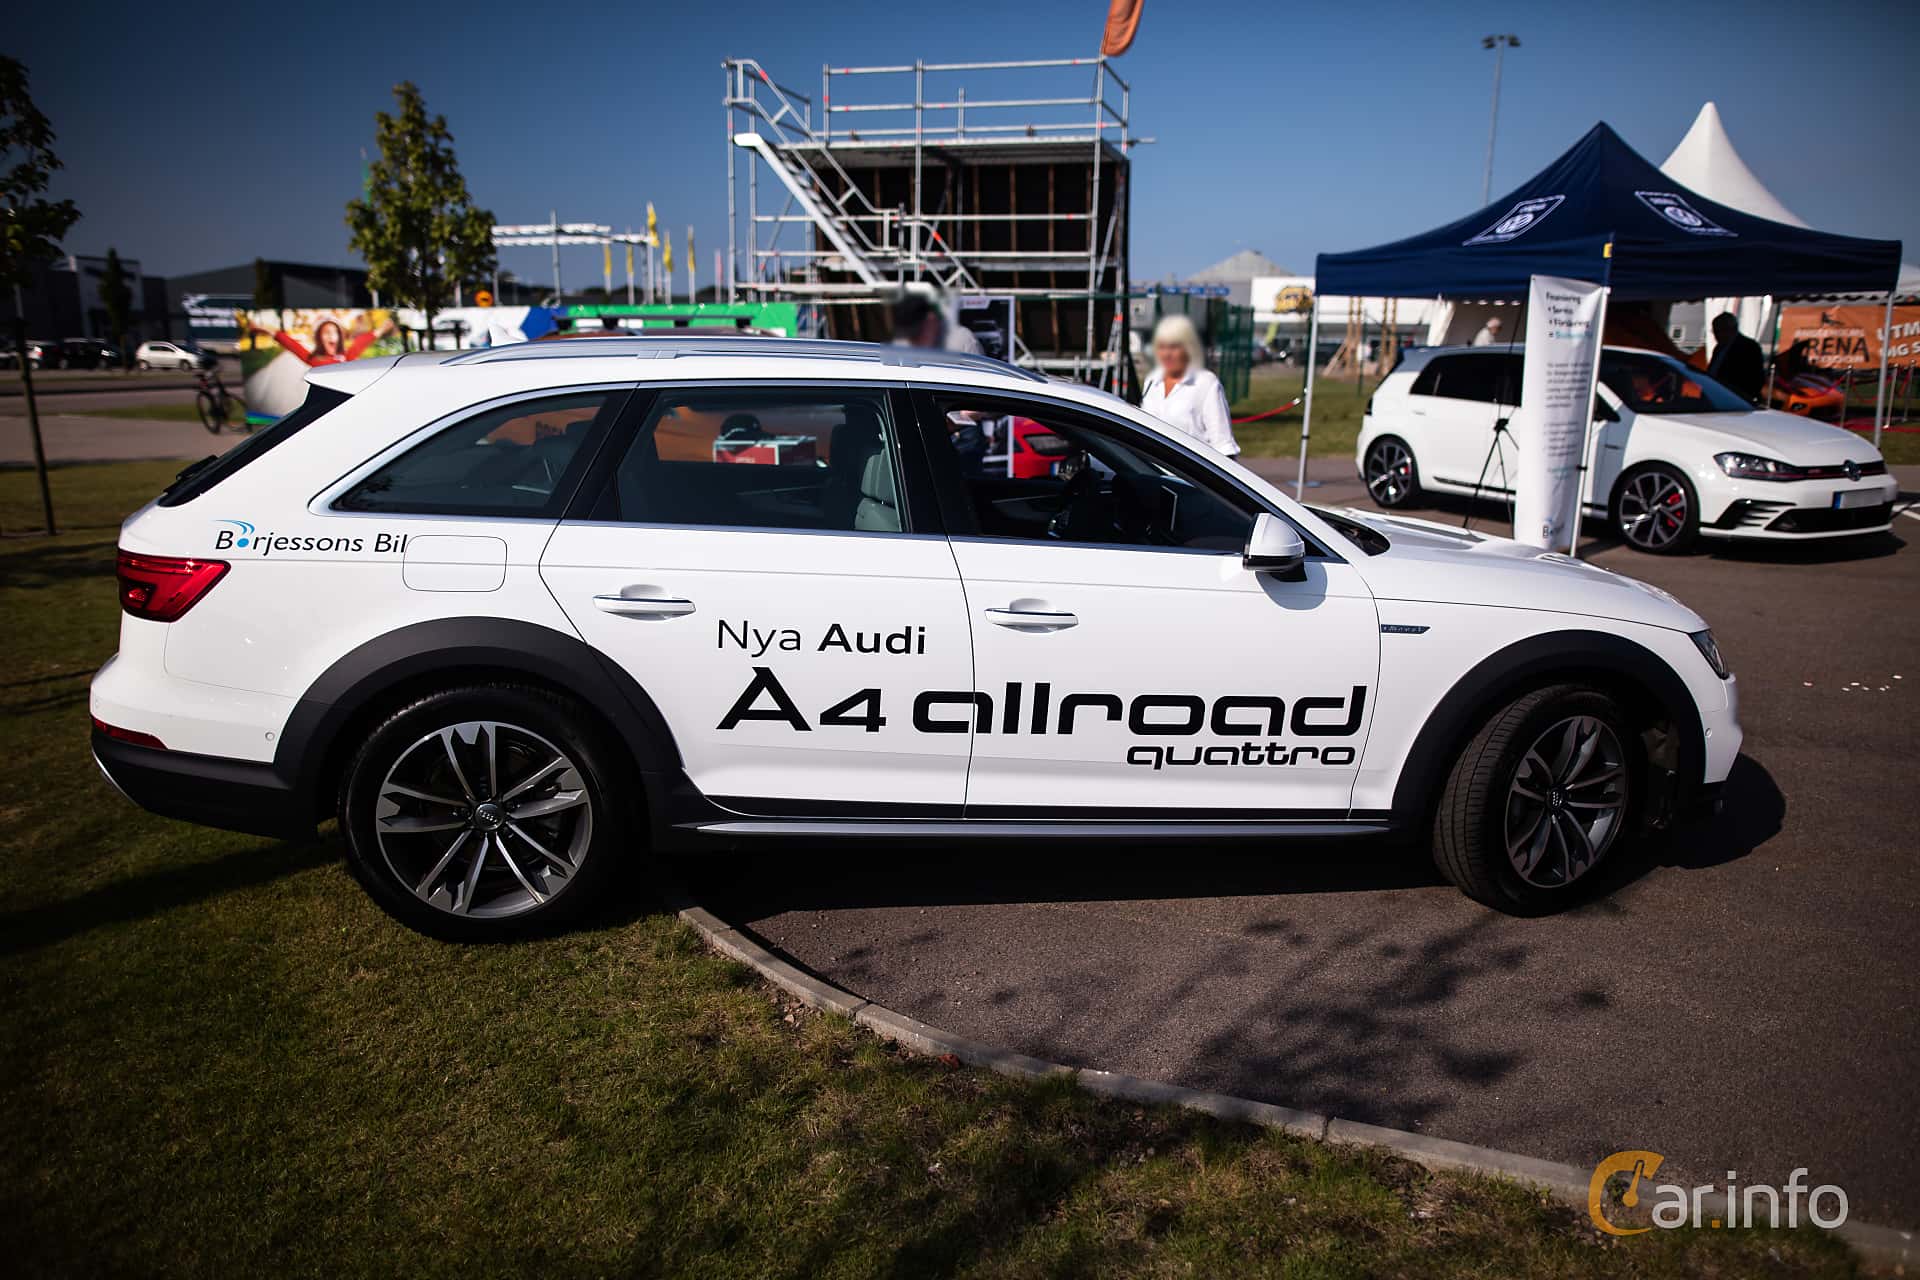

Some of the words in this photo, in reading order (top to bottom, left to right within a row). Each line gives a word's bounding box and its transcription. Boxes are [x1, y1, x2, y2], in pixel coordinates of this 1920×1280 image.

[374, 533, 408, 553] Bil
[717, 619, 801, 658] Nya
[817, 623, 926, 655] Audi
[716, 666, 887, 733] A4
[912, 682, 1367, 737] allroad
[1126, 742, 1356, 770] quattro
